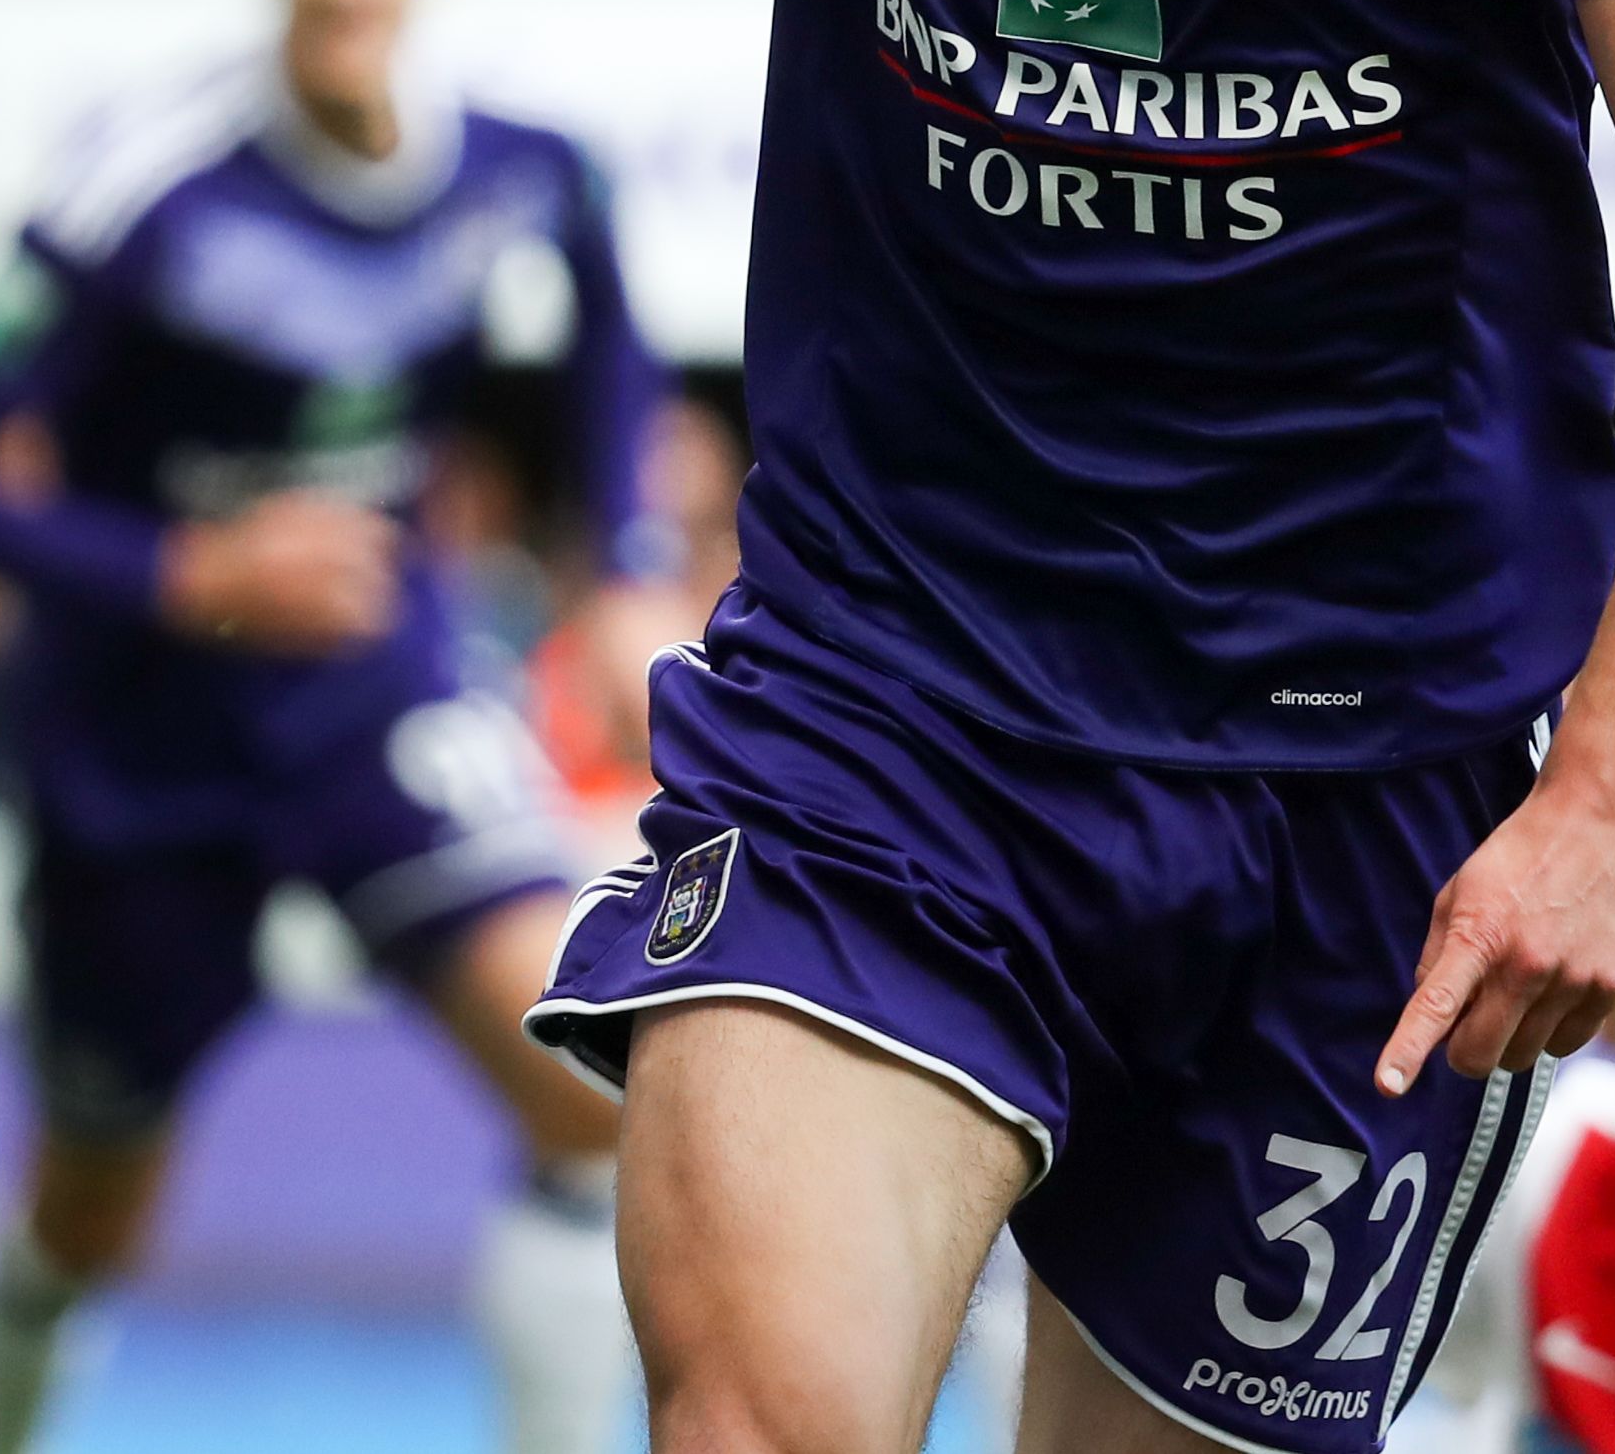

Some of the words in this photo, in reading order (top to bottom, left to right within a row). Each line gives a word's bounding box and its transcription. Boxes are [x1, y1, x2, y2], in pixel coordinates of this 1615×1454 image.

[993, 52, 1403, 140] PARIBAS
[926, 123, 1284, 241] FORTIS
[1270, 688, 1363, 706] climacool
[1214, 1132, 1428, 1361] 32
